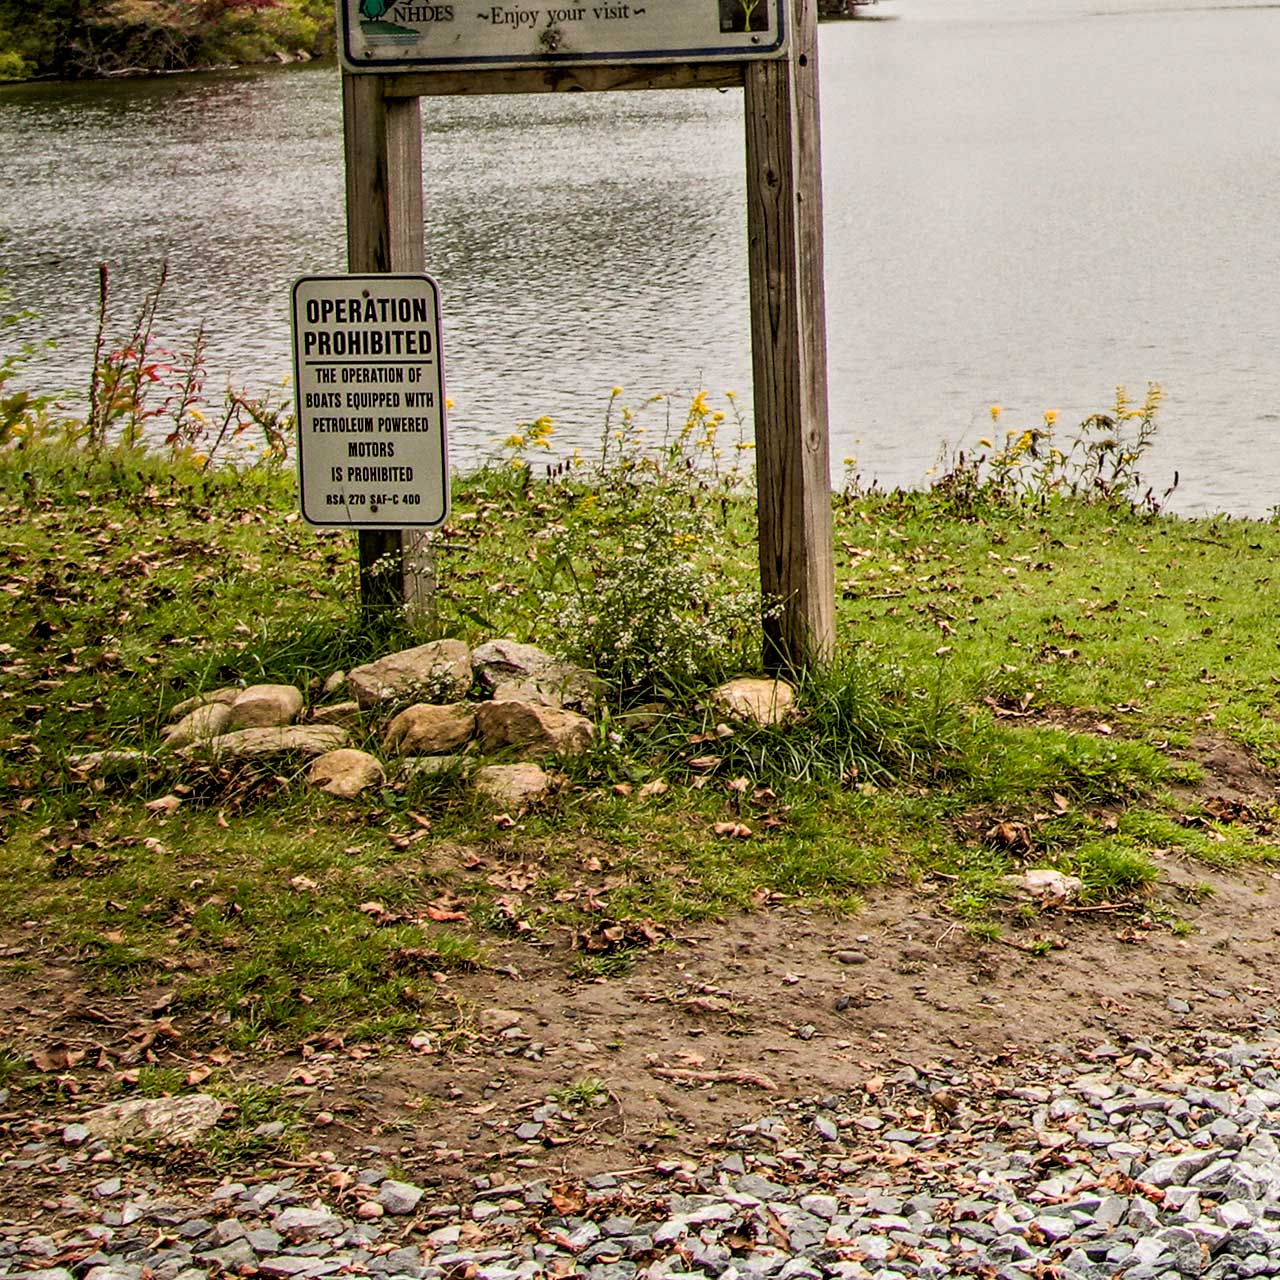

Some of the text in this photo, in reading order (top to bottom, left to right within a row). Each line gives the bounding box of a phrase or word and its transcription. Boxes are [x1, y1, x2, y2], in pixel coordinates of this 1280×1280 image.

[394, 5, 455, 23] NHDES
[546, 8, 586, 28] your
[306, 297, 427, 324] OPERATION
[304, 330, 432, 356] PROHIBITED
[315, 367, 422, 384] THE OPERATION OF
[305, 392, 434, 411] BOATS EQUIPPED WITH
[312, 417, 429, 433] PETROLEUM POWERED
[348, 442, 395, 458] MOTORS
[331, 467, 414, 482] IS PROHIBITED
[348, 494, 366, 505] 270
[370, 494, 399, 505] SAF-C
[402, 494, 420, 505] 400
